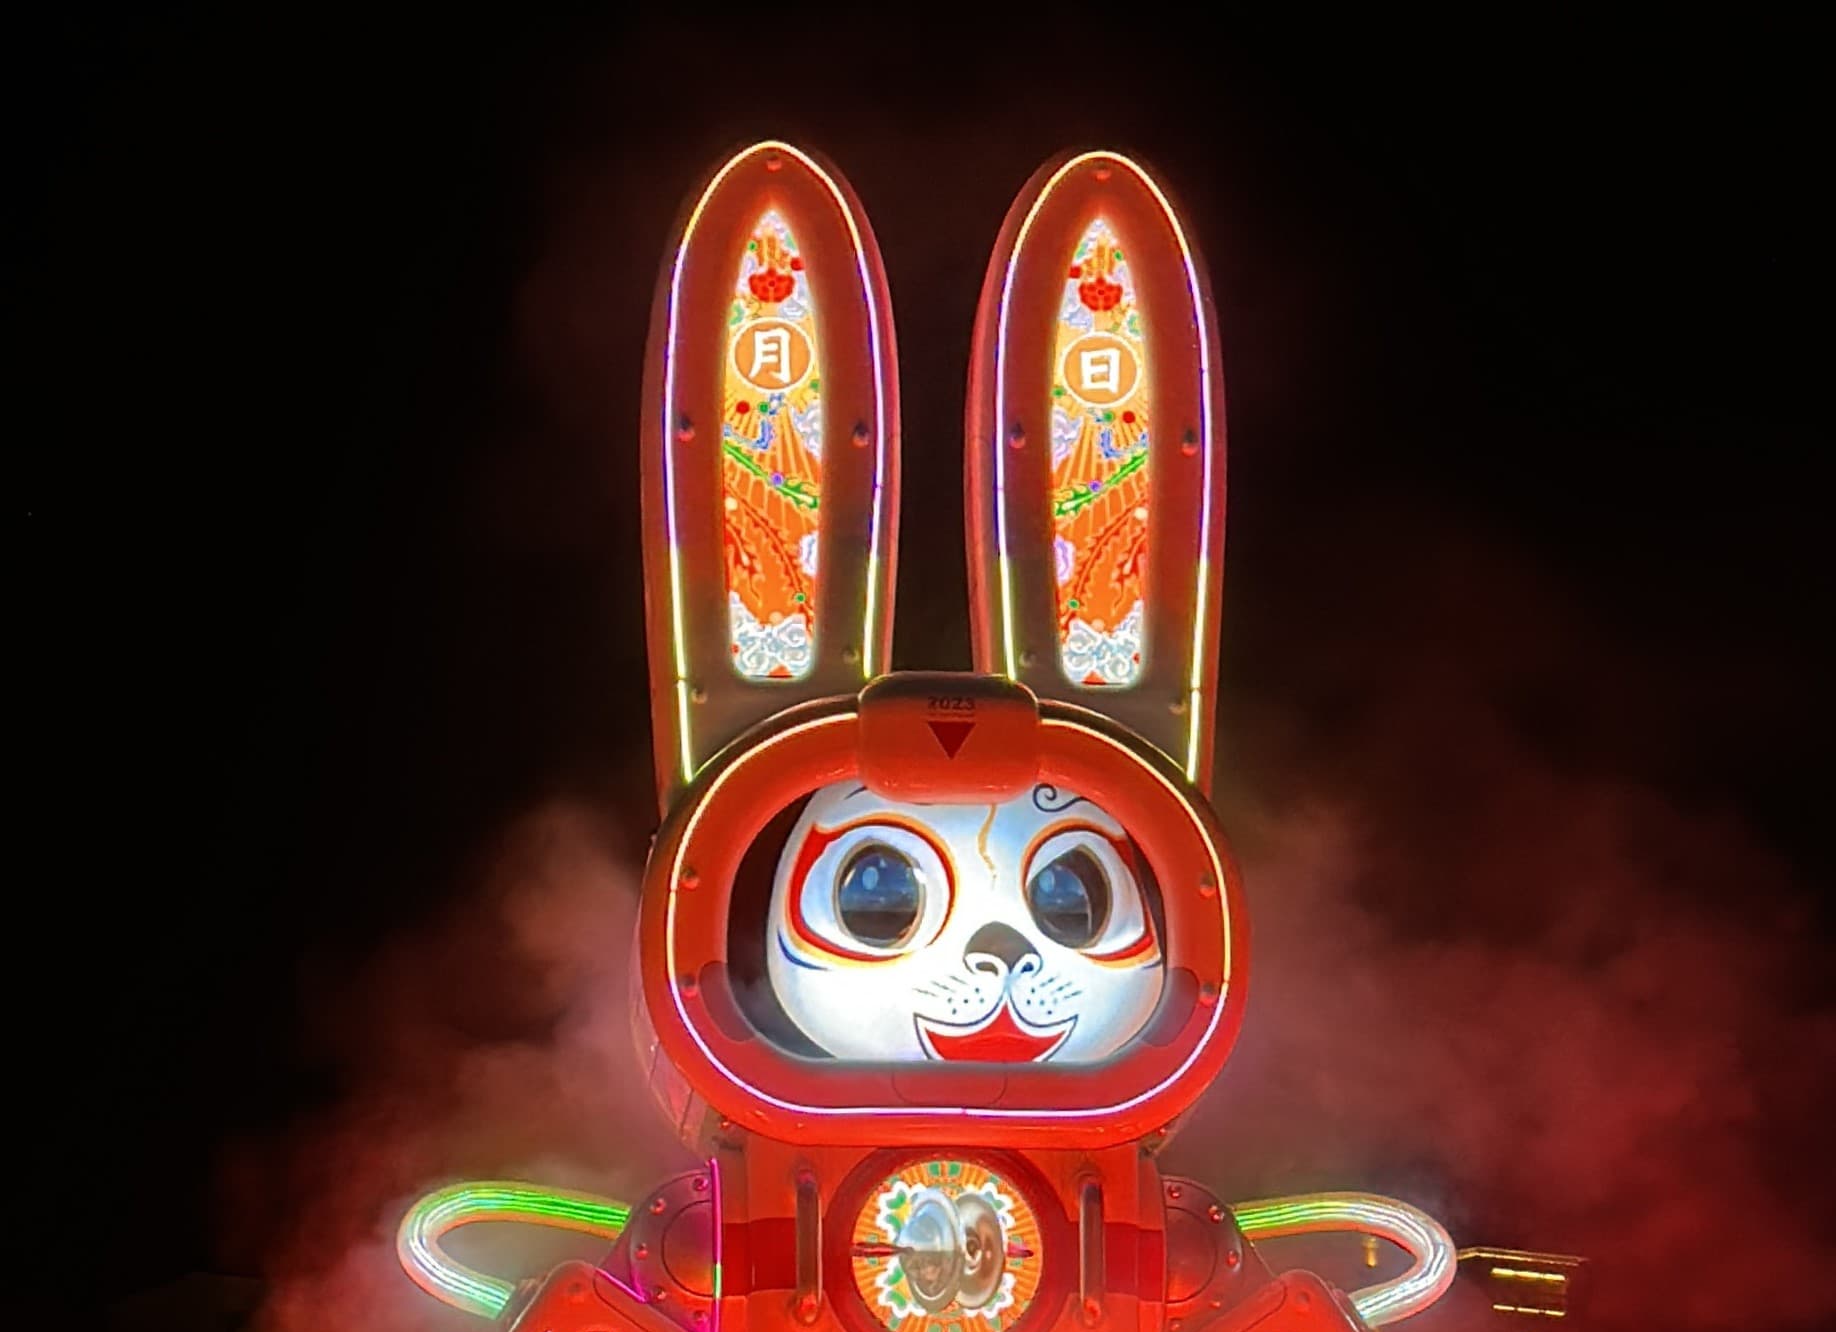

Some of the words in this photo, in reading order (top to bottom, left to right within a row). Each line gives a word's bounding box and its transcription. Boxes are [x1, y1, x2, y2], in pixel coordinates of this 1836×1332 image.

[747, 328, 791, 384] 月
[1080, 348, 1120, 393] 日
[927, 696, 977, 710] 2023
